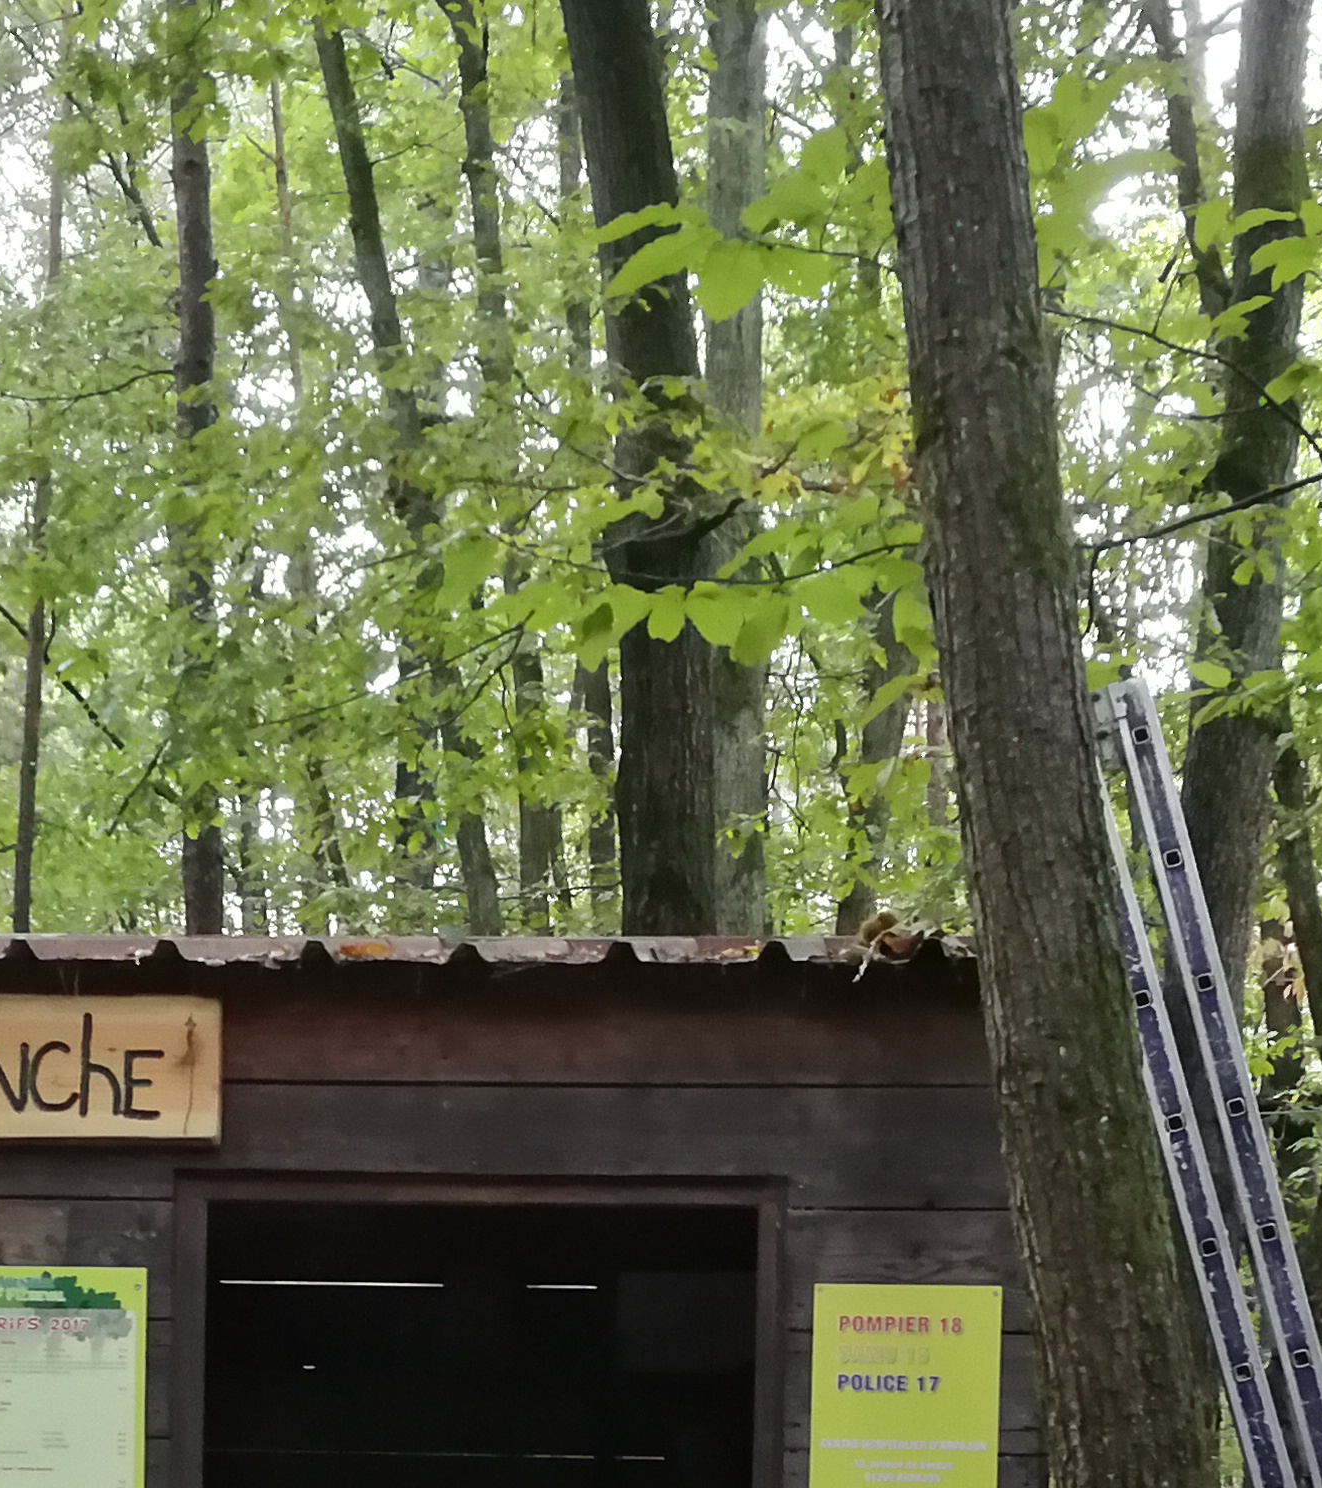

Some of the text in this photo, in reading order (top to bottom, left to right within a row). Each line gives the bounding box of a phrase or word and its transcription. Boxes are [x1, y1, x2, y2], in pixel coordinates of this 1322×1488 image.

[50, 1318, 90, 1332] 2017
[838, 1315, 963, 1334] POMPIER 18
[837, 1374, 941, 1392] POLICE 17
